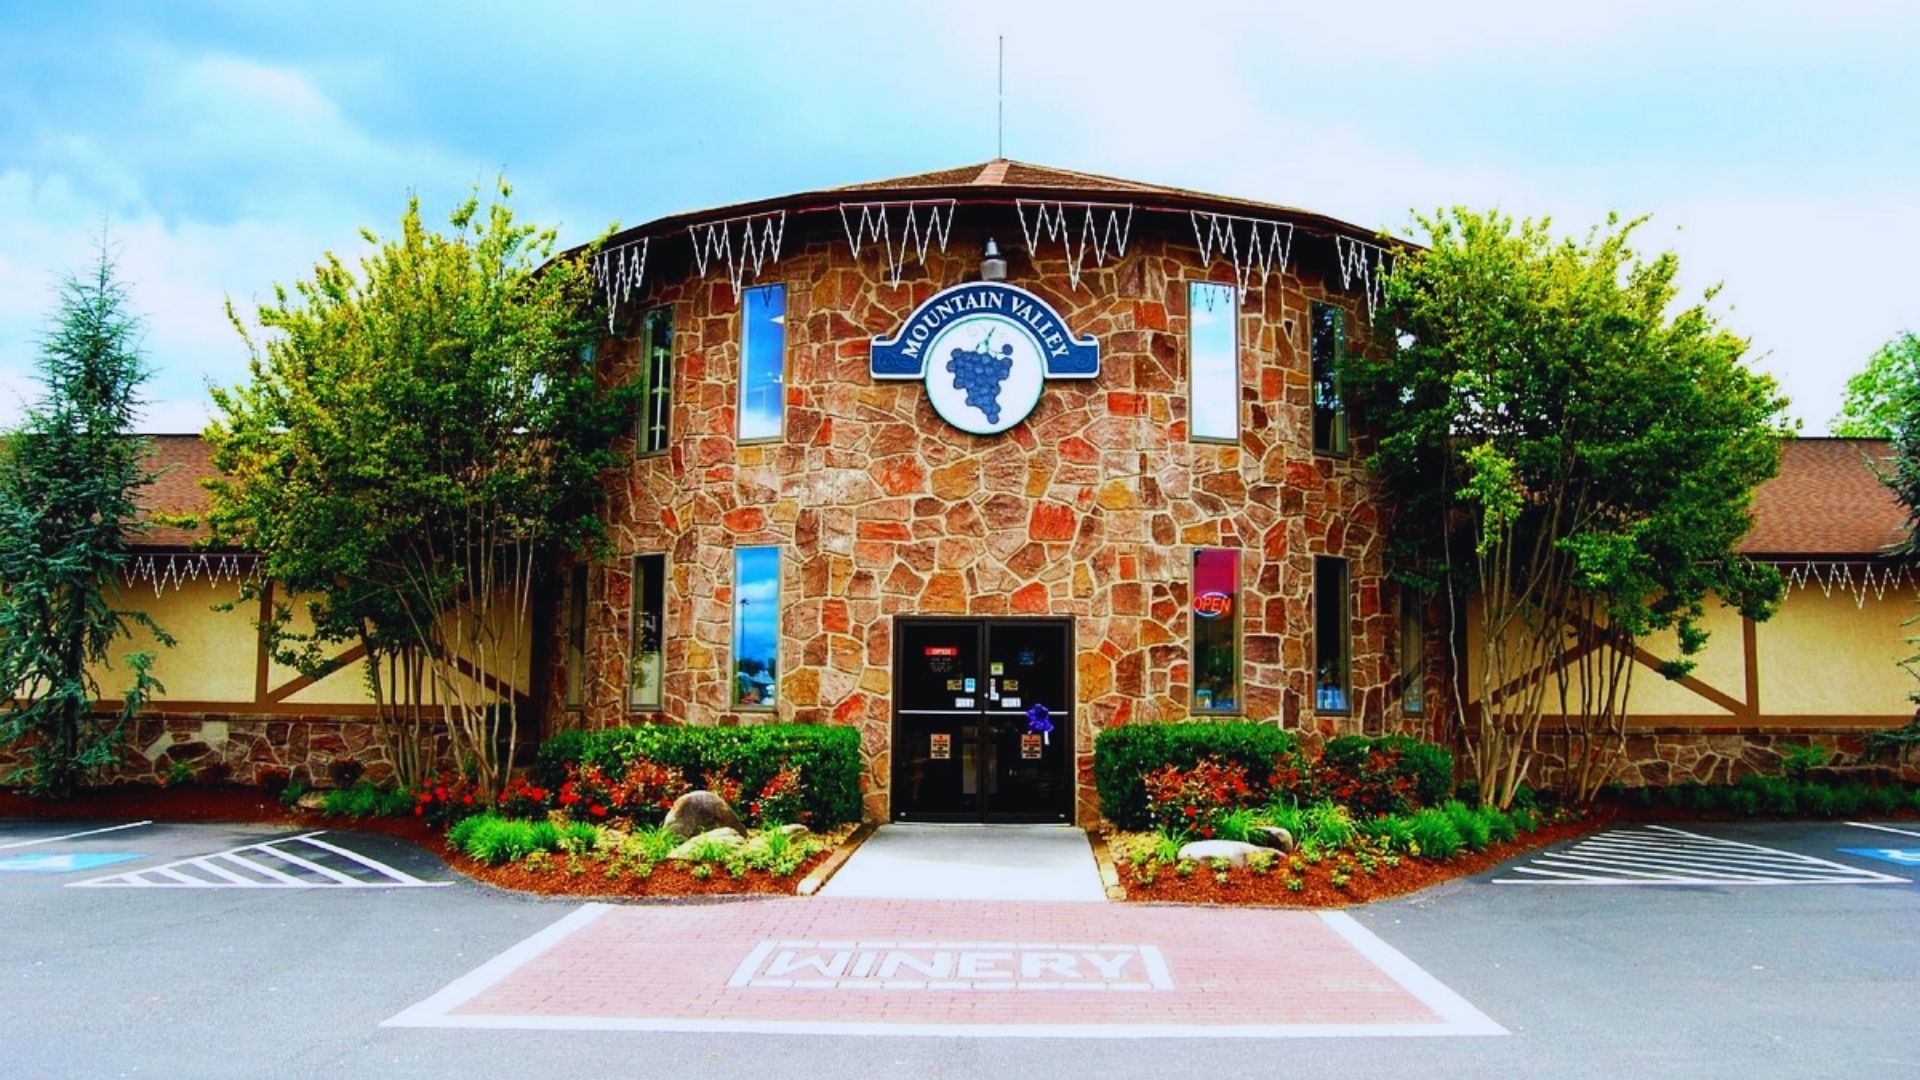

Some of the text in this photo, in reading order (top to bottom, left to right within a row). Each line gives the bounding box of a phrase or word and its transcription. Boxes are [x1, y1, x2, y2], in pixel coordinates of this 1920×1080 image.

[902, 291, 1069, 358] MOUNTAIN VALLEY
[1193, 597, 1231, 611] OPEN
[762, 951, 1138, 978] WINERY
